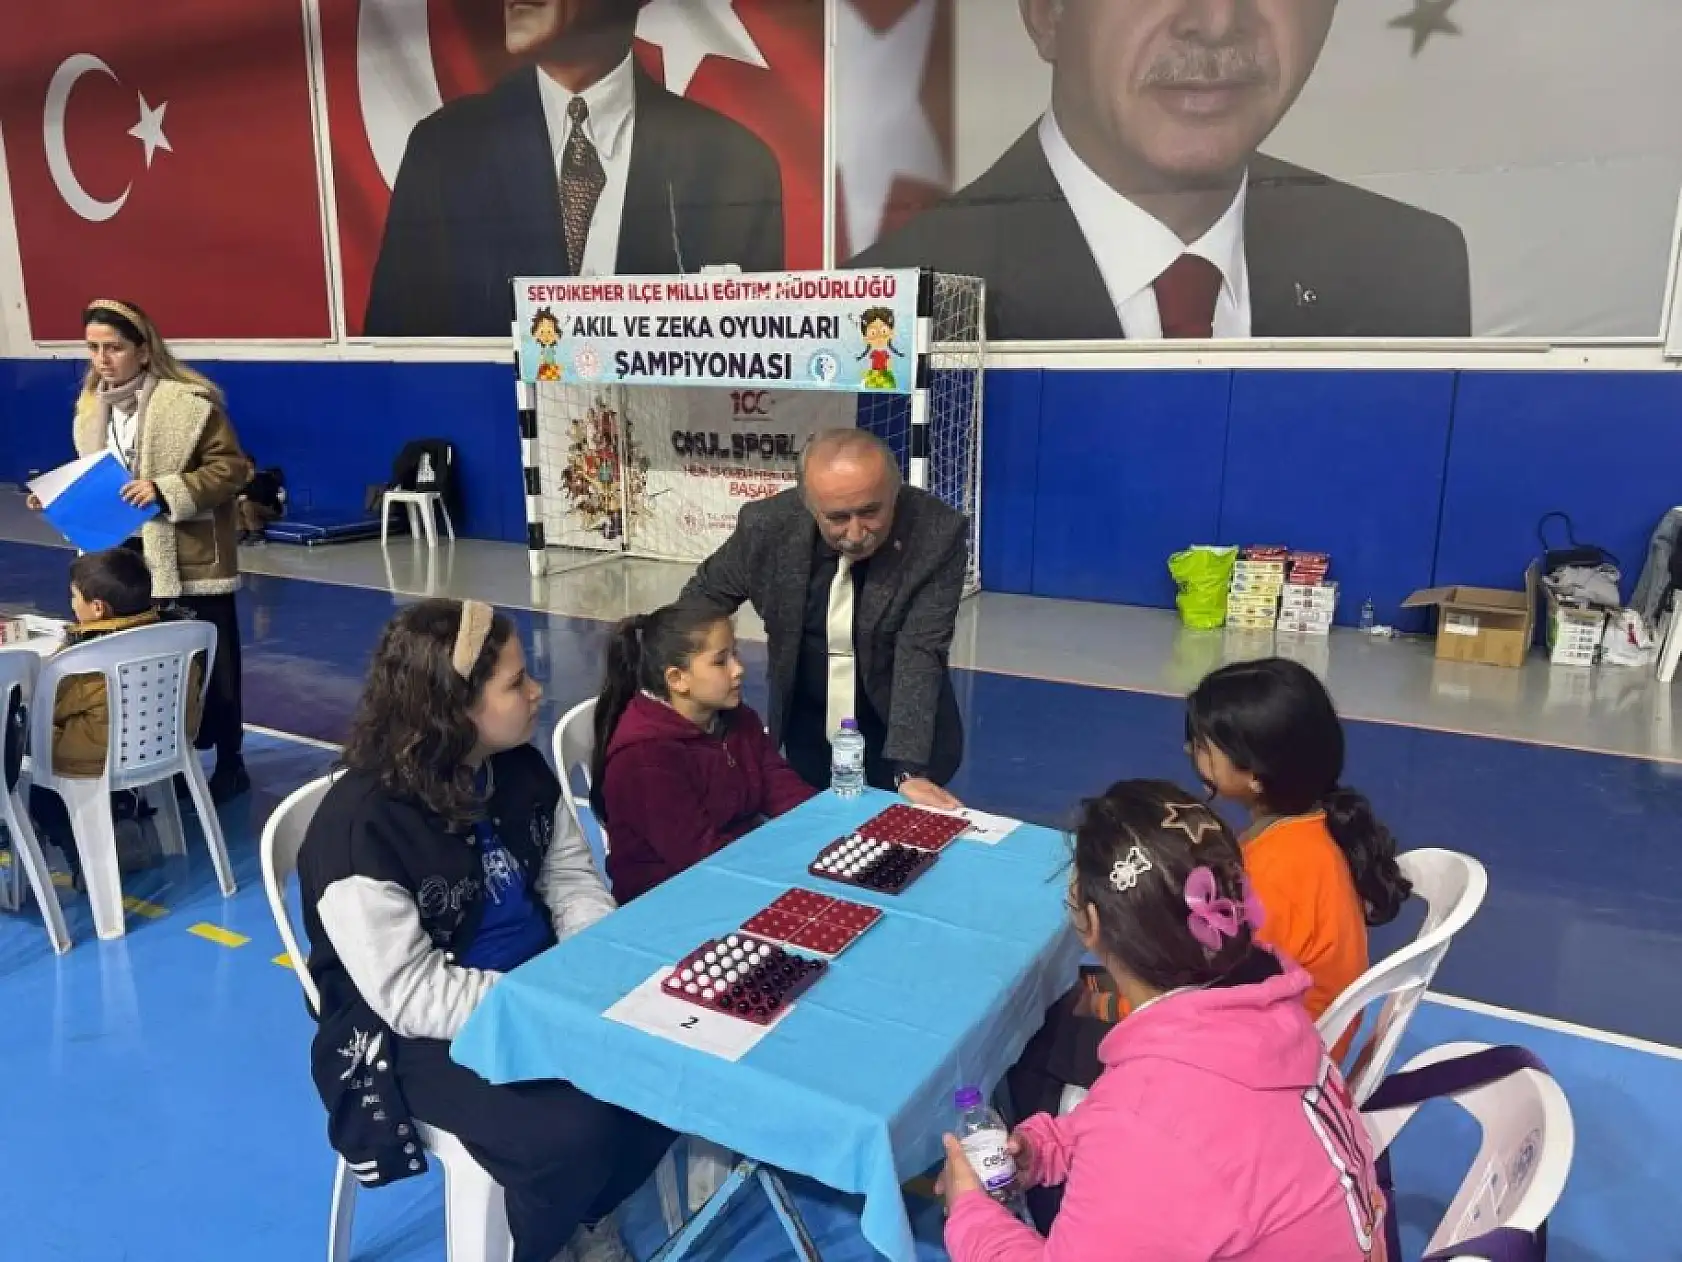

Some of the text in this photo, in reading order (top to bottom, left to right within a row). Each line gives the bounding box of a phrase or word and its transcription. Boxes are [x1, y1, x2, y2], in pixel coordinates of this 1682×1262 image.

[528, 275, 896, 303] SEYDİKEMER İLÇE MİLLİ EĞİTİM MÜDÜRLÜĞÜ
[572, 315, 839, 339] AKIL VE ZEKA OYUNLARI
[615, 350, 792, 379] ŞAMPİYONASI
[679, 1015, 699, 1029] 2
